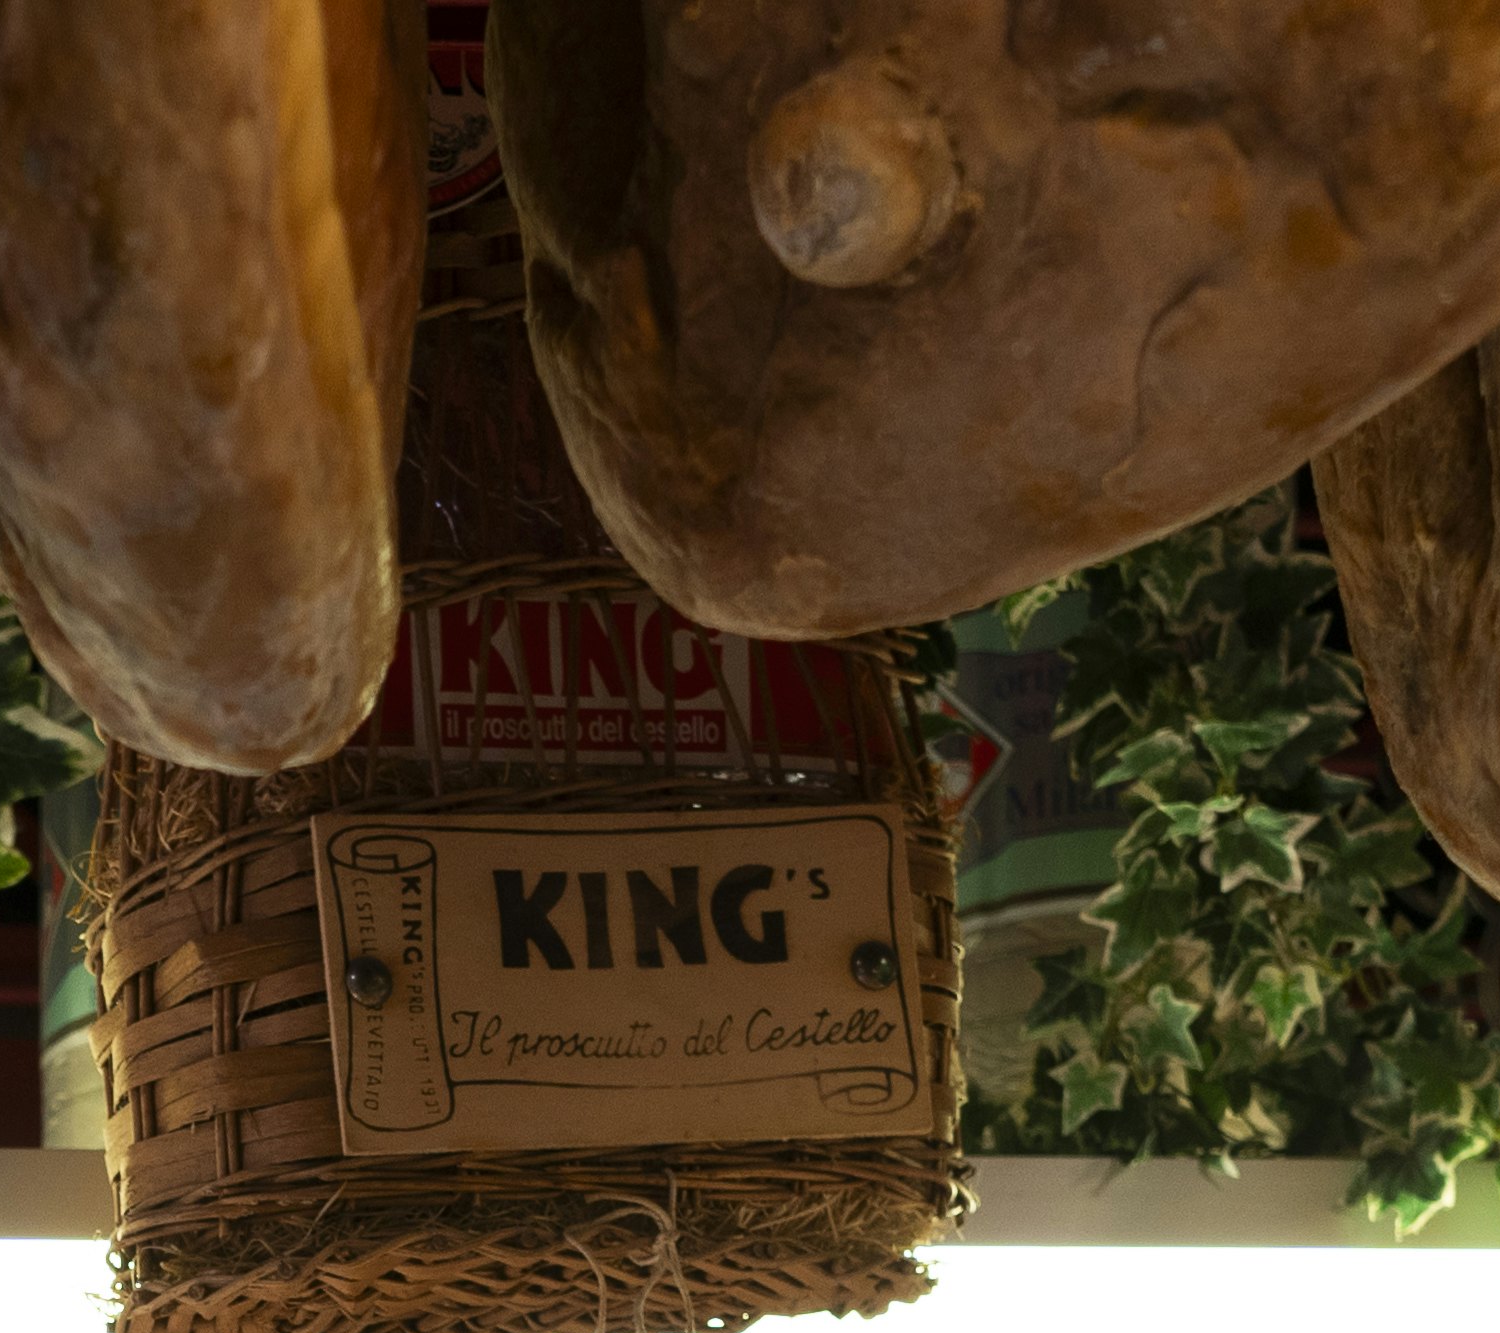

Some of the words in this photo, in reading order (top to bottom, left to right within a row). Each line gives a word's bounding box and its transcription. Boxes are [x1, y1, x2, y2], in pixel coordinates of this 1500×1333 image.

[446, 711, 459, 738] il
[589, 715, 624, 744] del
[351, 876, 379, 954] CESTELL
[684, 1014, 734, 1058] del
[745, 1007, 898, 1054] Cestello
